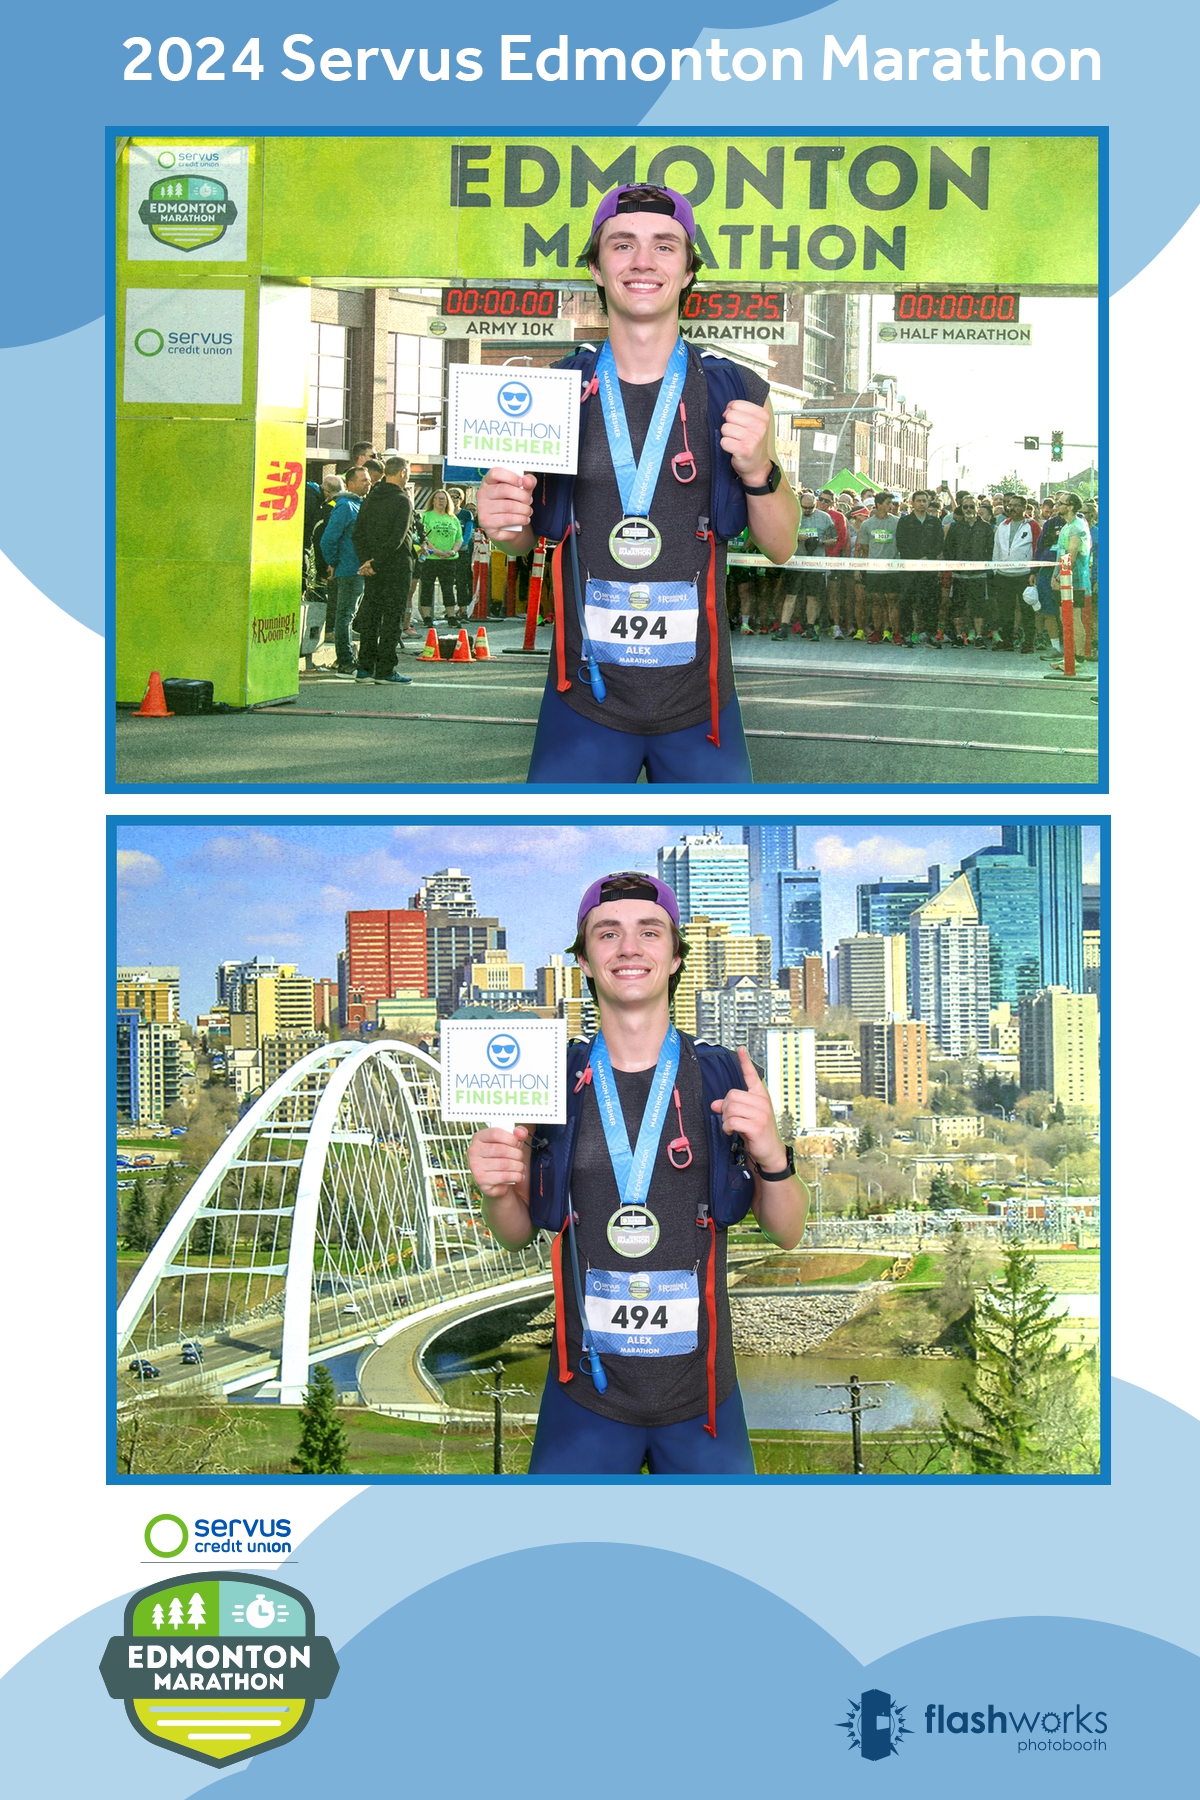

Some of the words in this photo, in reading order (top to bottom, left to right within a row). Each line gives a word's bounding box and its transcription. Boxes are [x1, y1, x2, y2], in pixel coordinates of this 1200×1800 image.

[178, 151, 220, 161] servus
[450, 145, 991, 212] EDMONTON
[149, 203, 227, 214] EDMONTON
[160, 214, 216, 222] MARATHON
[523, 222, 907, 272] MATHON
[465, 321, 518, 336] ARMY
[522, 322, 555, 337] 10K
[680, 325, 785, 341] MARATHON
[900, 328, 939, 340] HALF
[943, 328, 1031, 341] MARATHON
[168, 332, 233, 345] servus
[168, 345, 200, 355] credit
[203, 346, 233, 355] union
[603, 370, 615, 406] MARATHON
[610, 406, 621, 438] FINISHER
[655, 404, 670, 441] MARATHON
[666, 372, 680, 403] FINISHER
[463, 418, 561, 440] MARATHON
[463, 435, 561, 456] FINISHER!
[610, 615, 668, 640] 494
[625, 646, 651, 655] ALEX
[455, 1073, 549, 1090] MARATHON
[455, 1090, 549, 1106] FINISHER!
[596, 1060, 609, 1095] MARATHON
[604, 1095, 616, 1127] FINISHER
[650, 1090, 664, 1128] MARATHON
[660, 1059, 673, 1090] FINISHER
[611, 1305, 668, 1330] 494
[626, 1336, 652, 1345] ALEX
